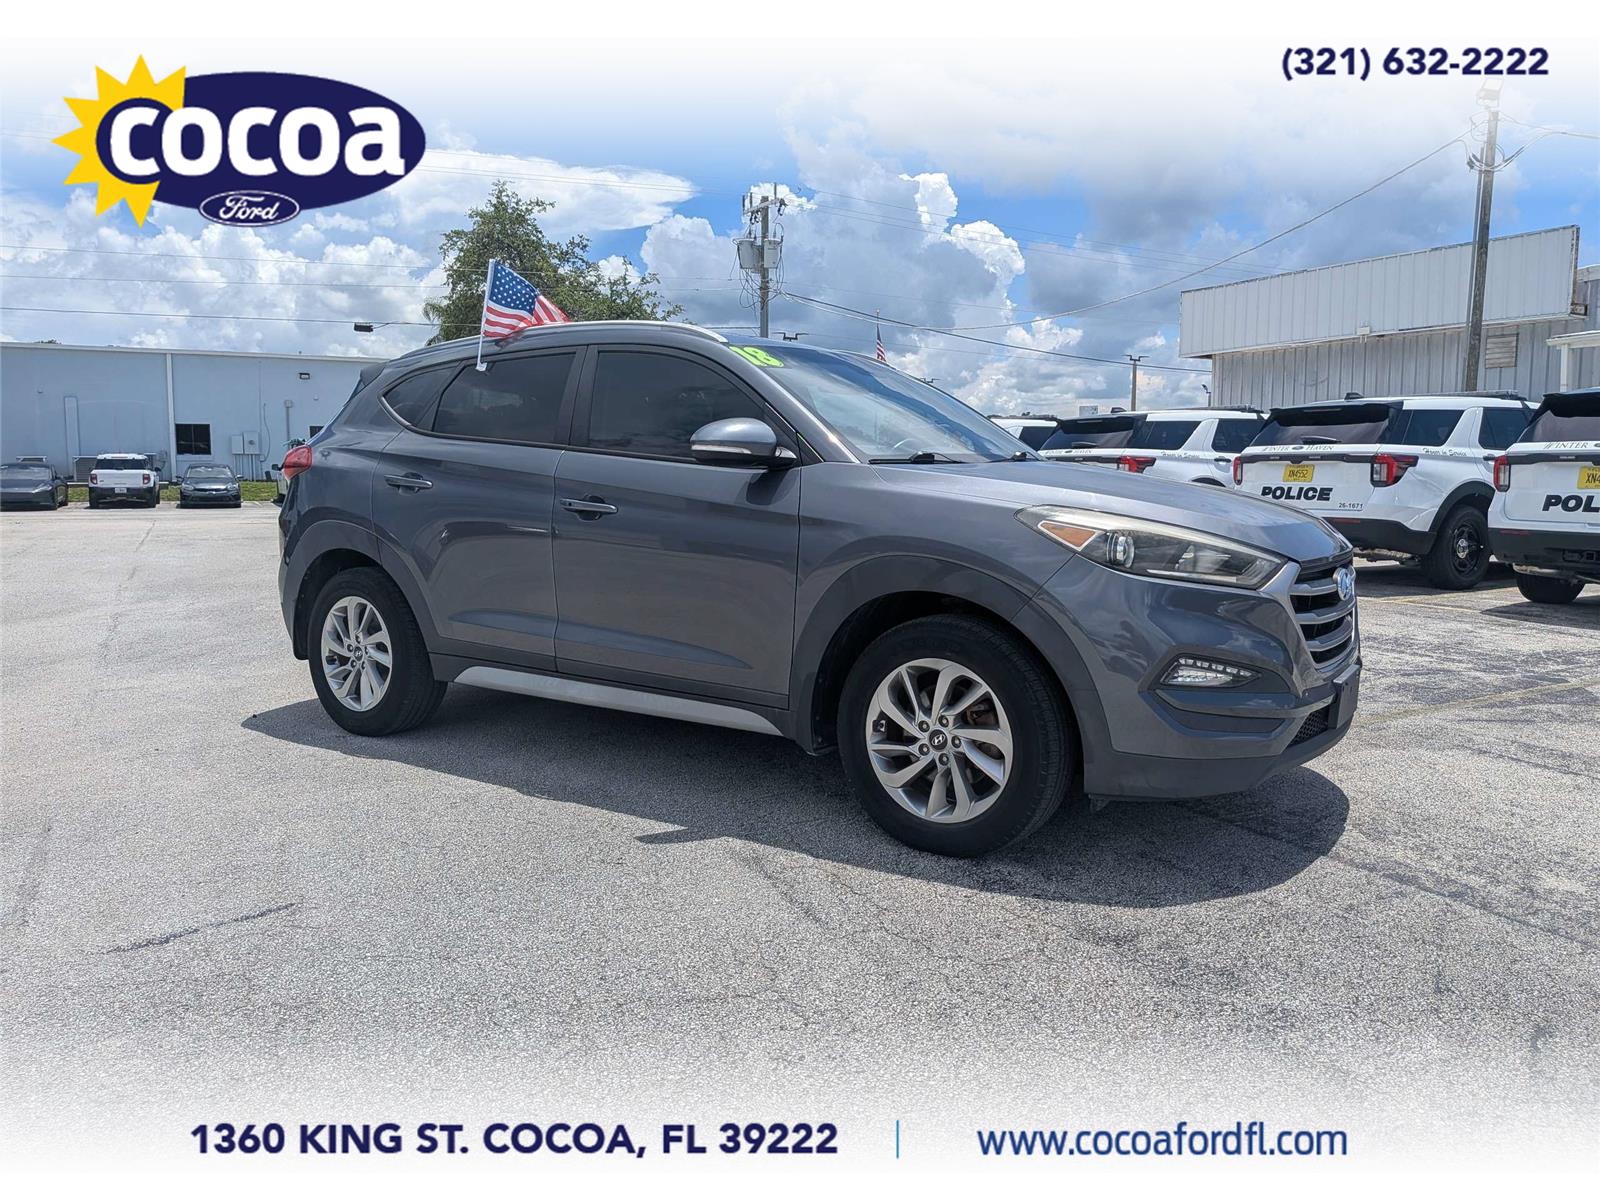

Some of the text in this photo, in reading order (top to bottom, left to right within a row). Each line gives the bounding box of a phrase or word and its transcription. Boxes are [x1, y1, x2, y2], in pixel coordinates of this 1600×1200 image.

[729, 345, 784, 368] 18
[1261, 486, 1333, 501] POLICE
[1542, 494, 1600, 513] POL
